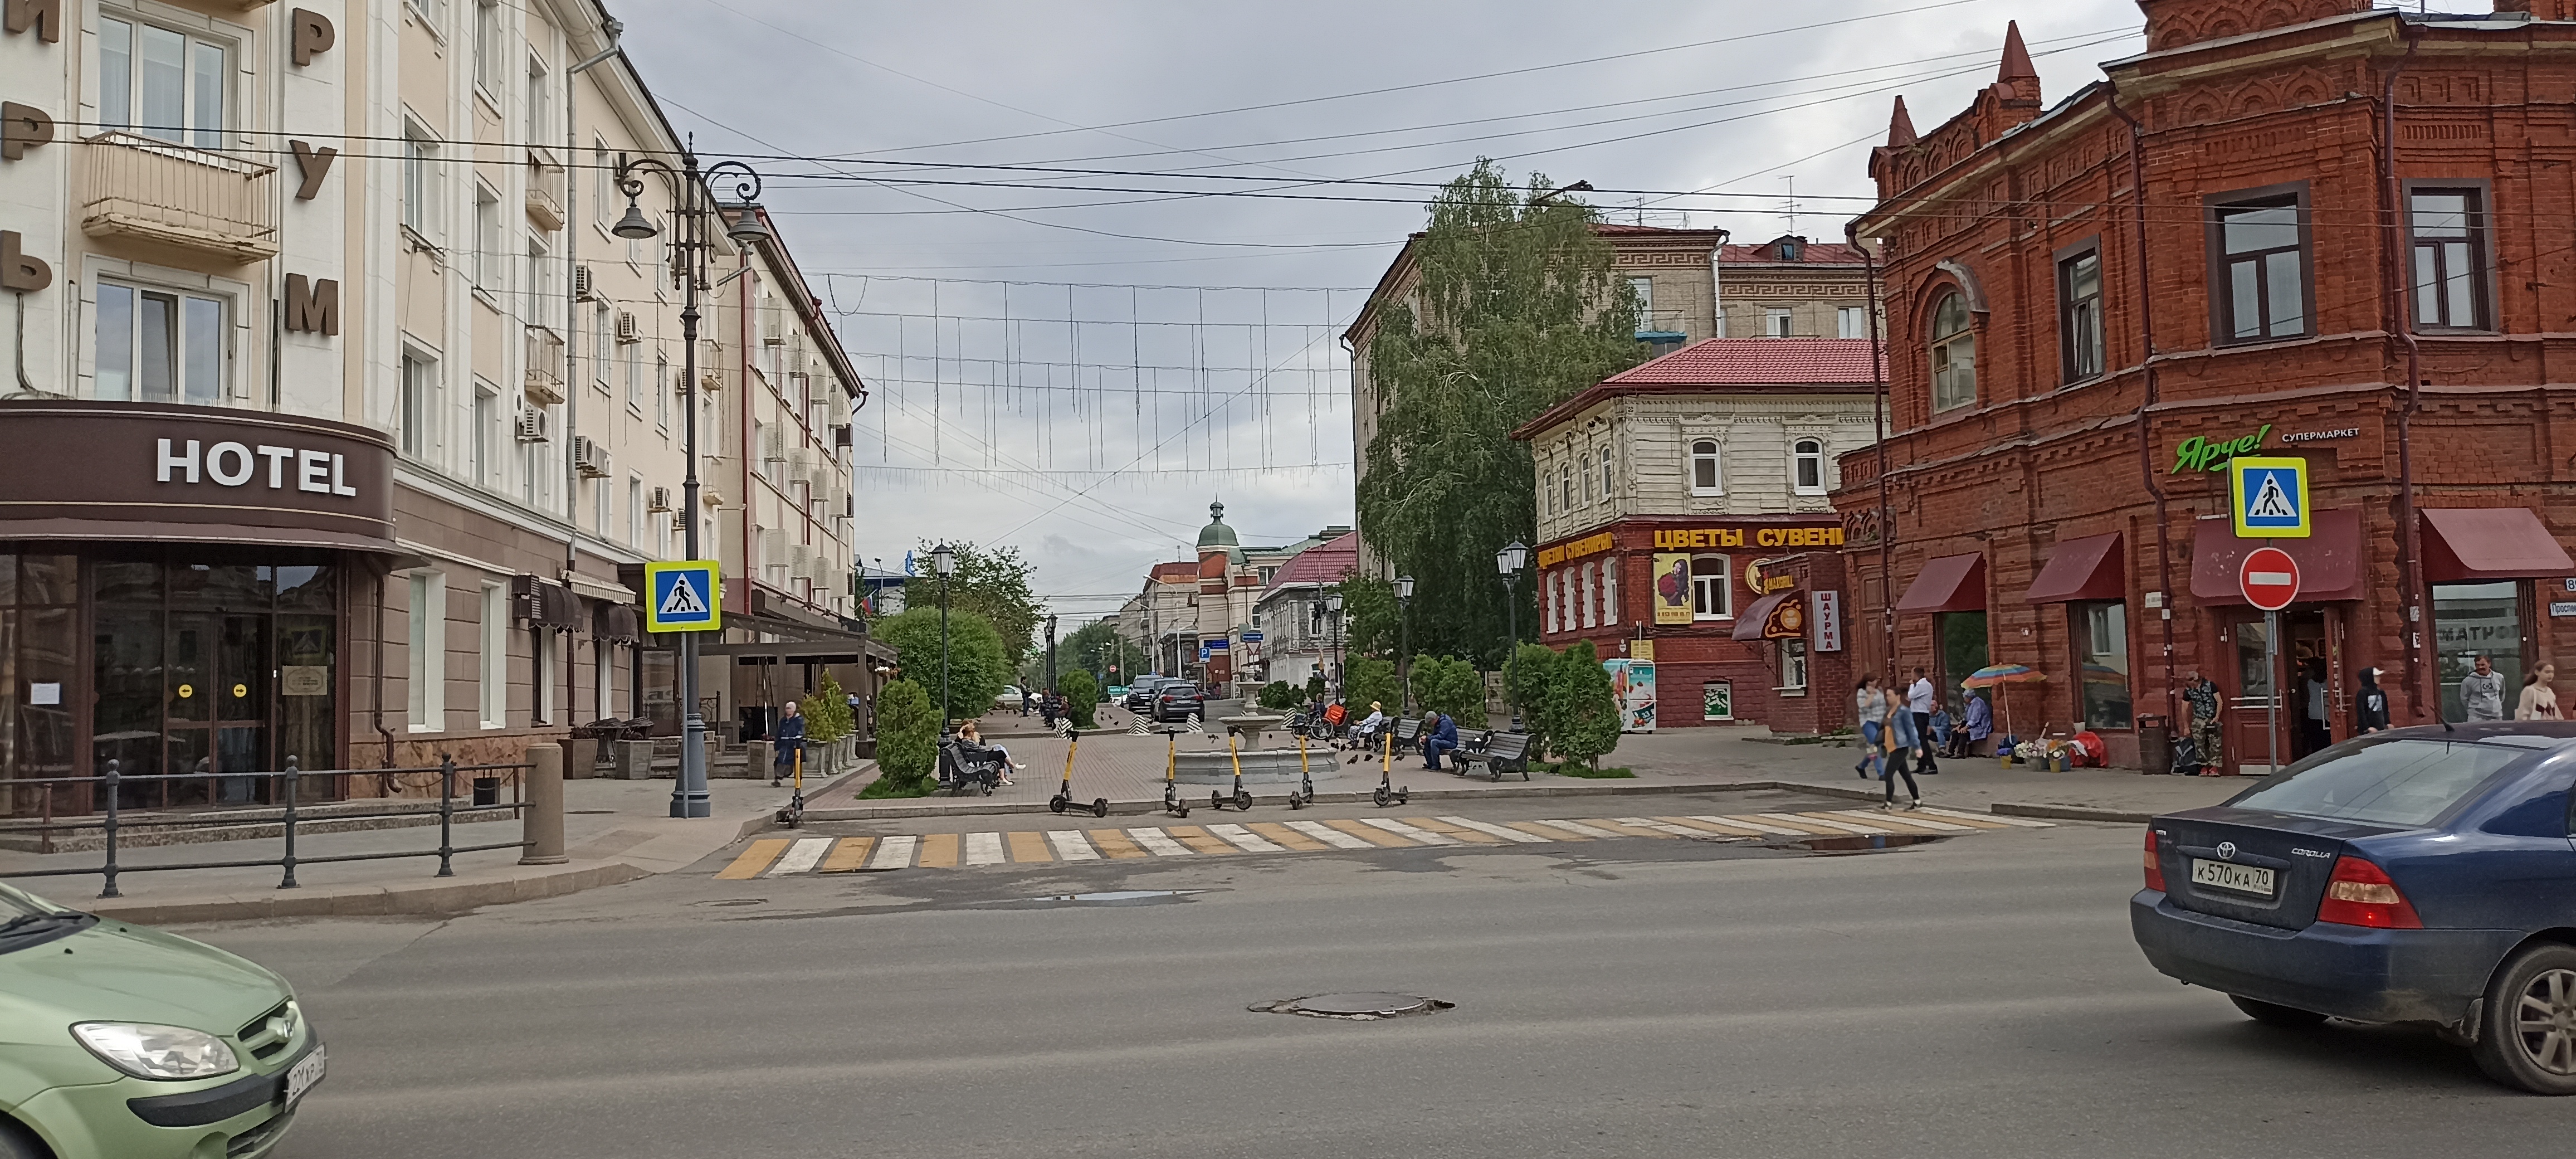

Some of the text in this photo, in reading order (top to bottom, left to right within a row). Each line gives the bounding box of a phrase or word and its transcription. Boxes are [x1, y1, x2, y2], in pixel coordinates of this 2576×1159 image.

[2282, 427, 2359, 442] СУПЕРМАРКЕТ
[2172, 424, 2271, 474] Ярче!
[157, 438, 357, 496] HOTEL
[1566, 532, 1613, 559] СУВЕНИРЫ
[1654, 529, 1743, 551] ЦВЕТЫ
[2568, 580, 2576, 590] 8
[1820, 593, 1833, 649] ШАУРМА
[2291, 848, 2331, 859] COROLLA
[2256, 869, 2268, 885] 70
